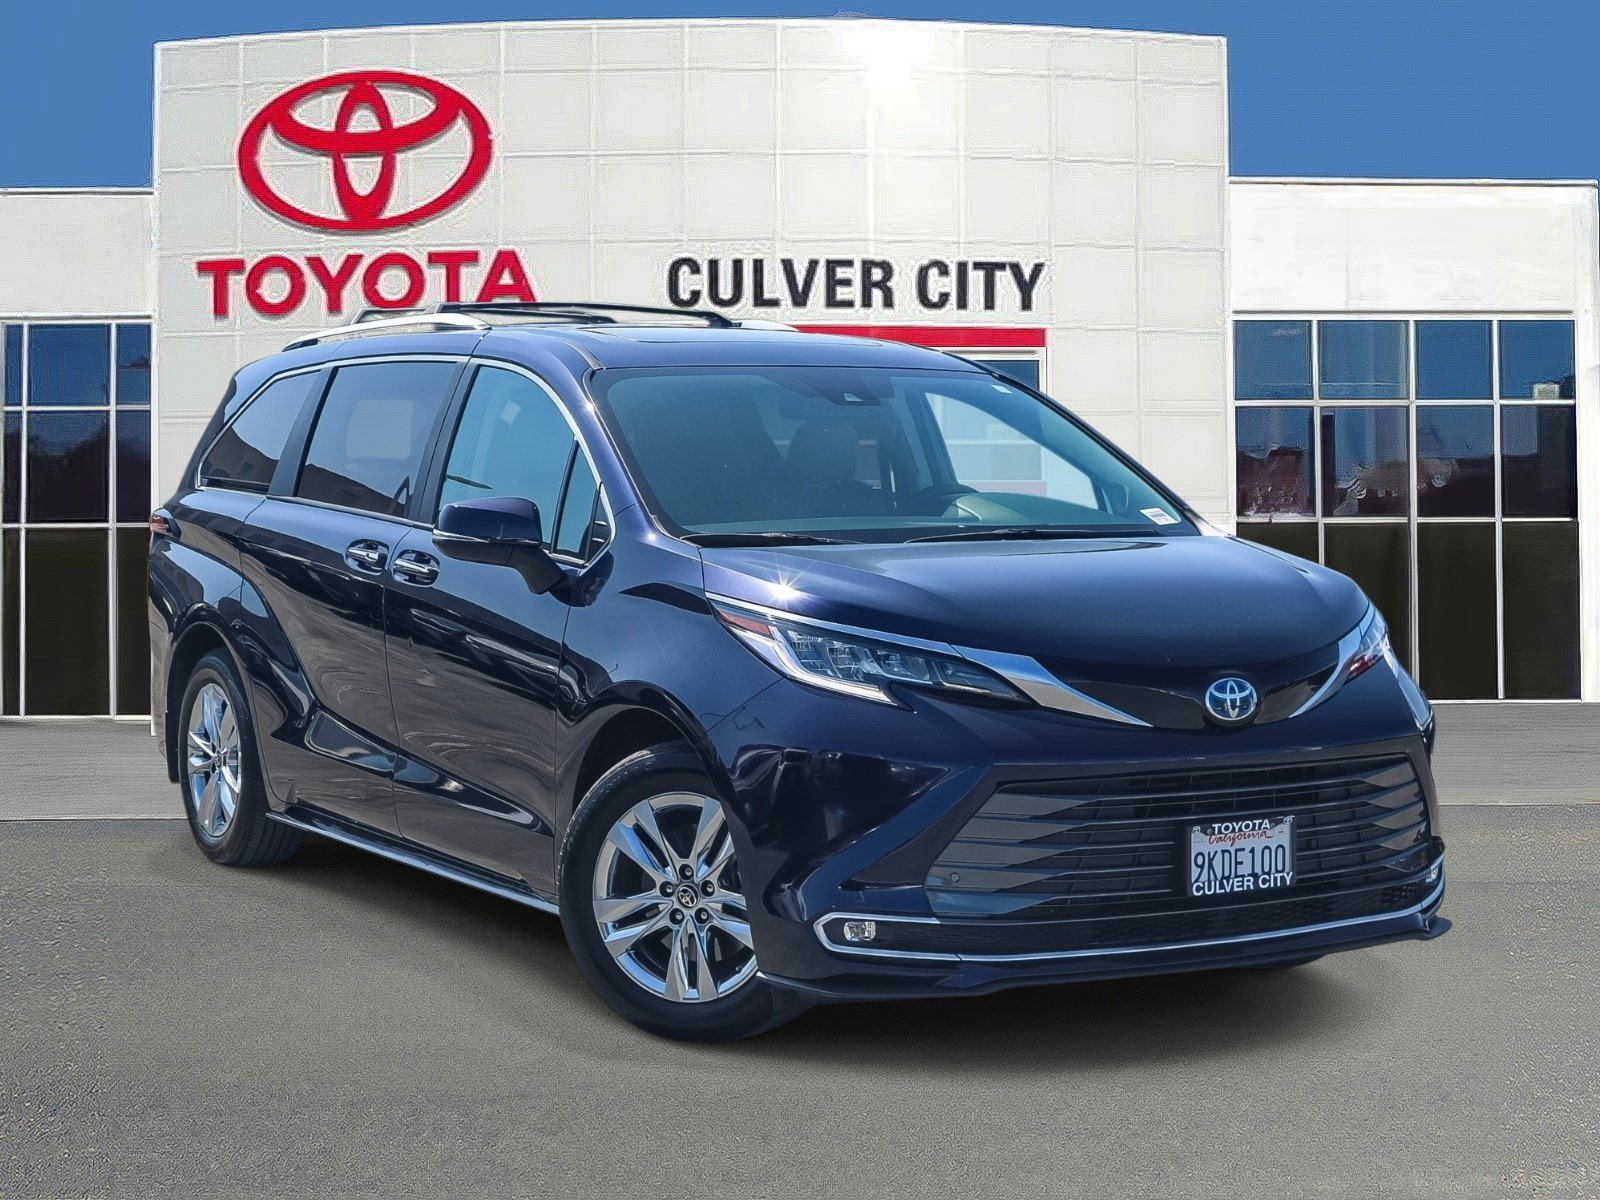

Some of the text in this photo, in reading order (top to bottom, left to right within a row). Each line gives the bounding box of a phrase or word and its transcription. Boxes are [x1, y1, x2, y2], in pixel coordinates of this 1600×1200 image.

[196, 249, 537, 317] TOYOTA
[668, 257, 1046, 311] CULVER CITY
[1208, 830, 1274, 847] California
[1212, 820, 1271, 834] TOYOTA
[1193, 844, 1286, 883] 9KDE100
[1193, 873, 1293, 896] CULVER CITY
